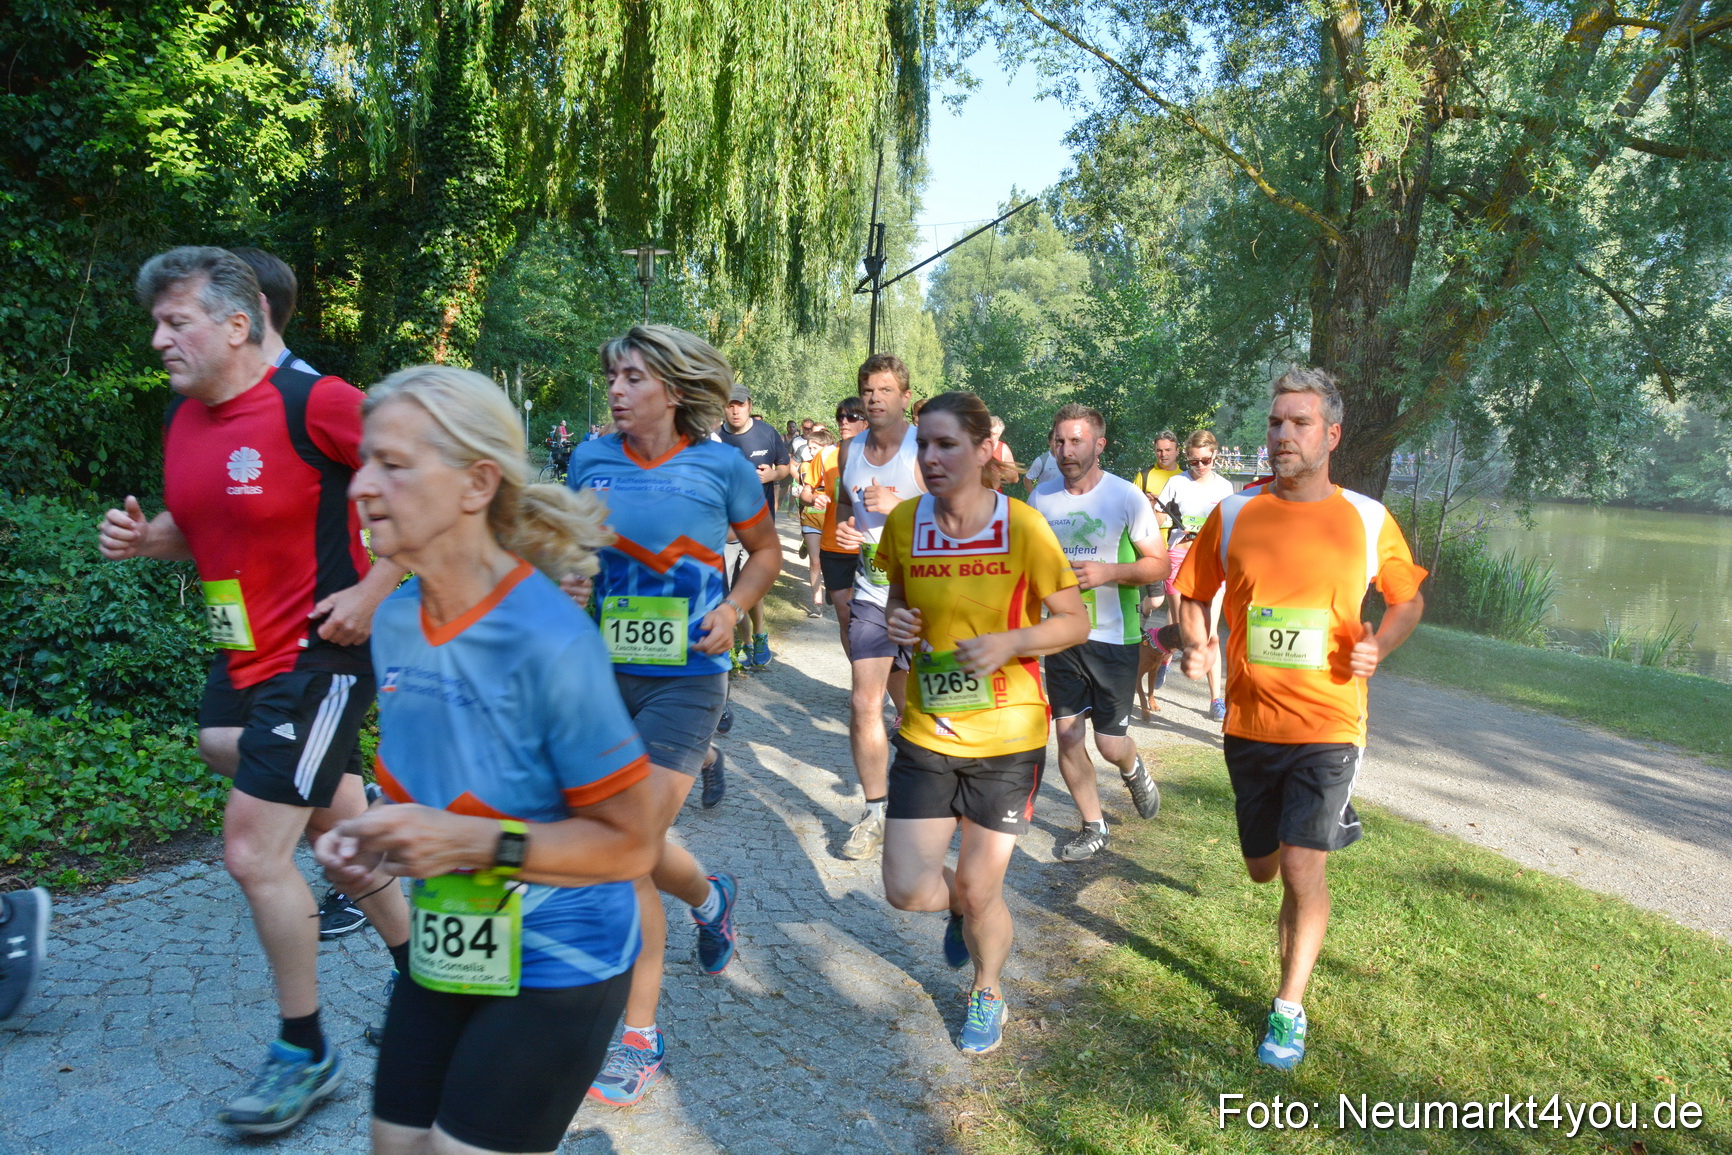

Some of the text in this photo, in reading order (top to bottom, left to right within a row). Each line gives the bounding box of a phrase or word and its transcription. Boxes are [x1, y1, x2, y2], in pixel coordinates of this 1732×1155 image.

[1062, 545, 1097, 556] aufend
[910, 559, 1012, 578] MAX BÖGL
[610, 620, 674, 645] 1586
[1269, 629, 1300, 651] 97
[923, 671, 979, 695] 1265
[413, 911, 497, 959] 1584
